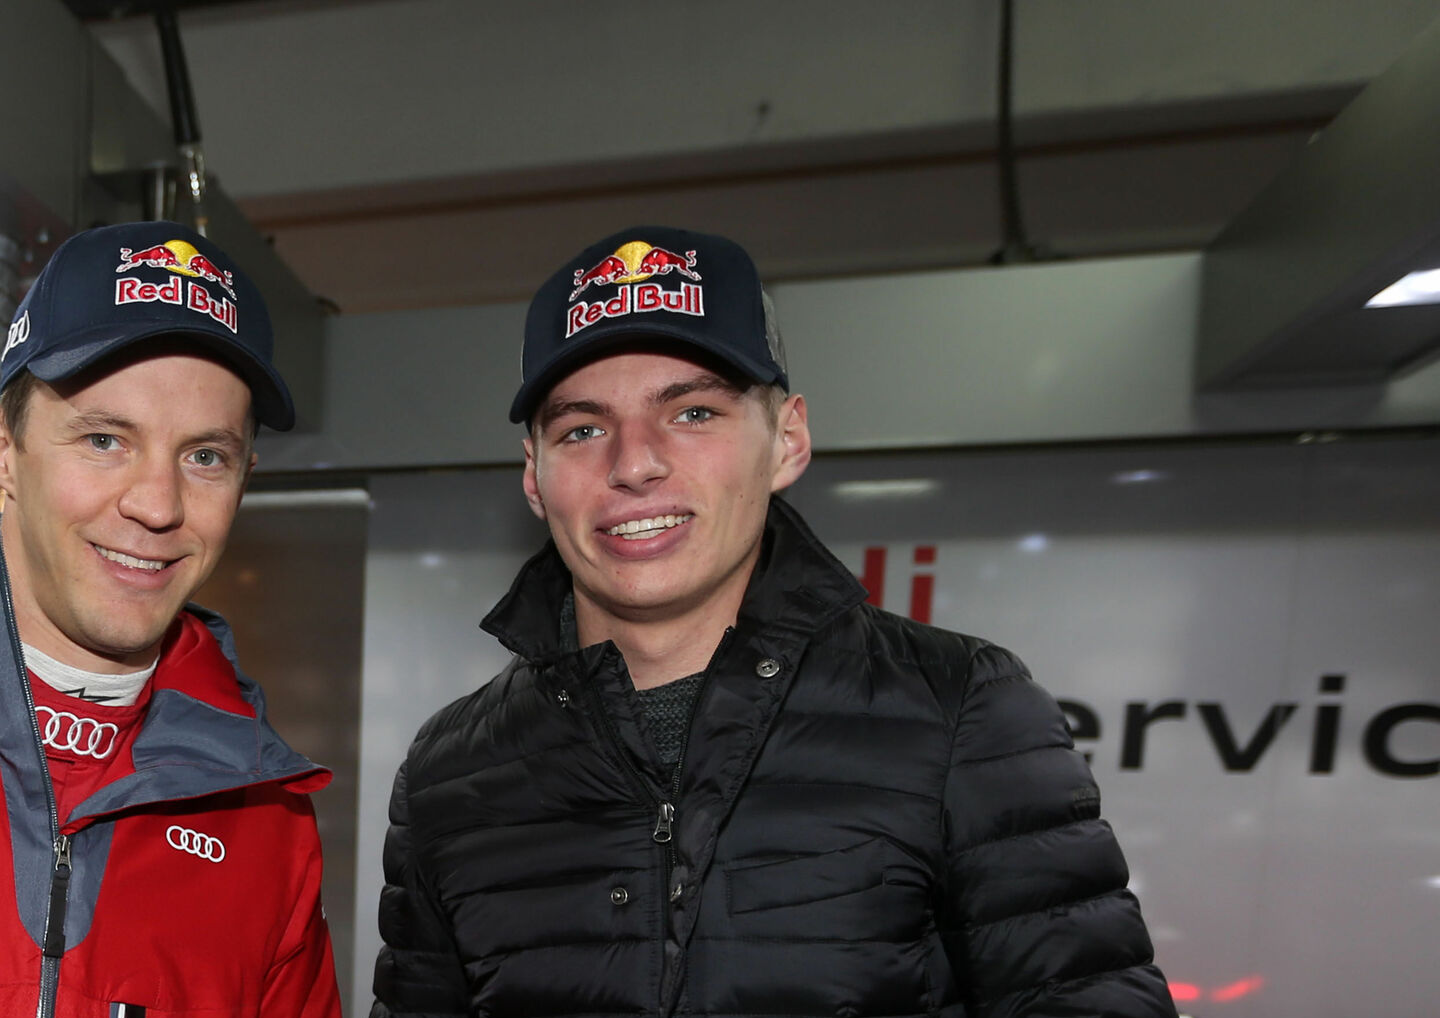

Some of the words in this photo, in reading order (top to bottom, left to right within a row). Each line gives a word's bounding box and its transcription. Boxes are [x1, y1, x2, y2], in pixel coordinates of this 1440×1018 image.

[115, 275, 183, 306] Red
[187, 281, 238, 334] Bull
[565, 284, 631, 338] Red
[634, 282, 705, 317] Bull
